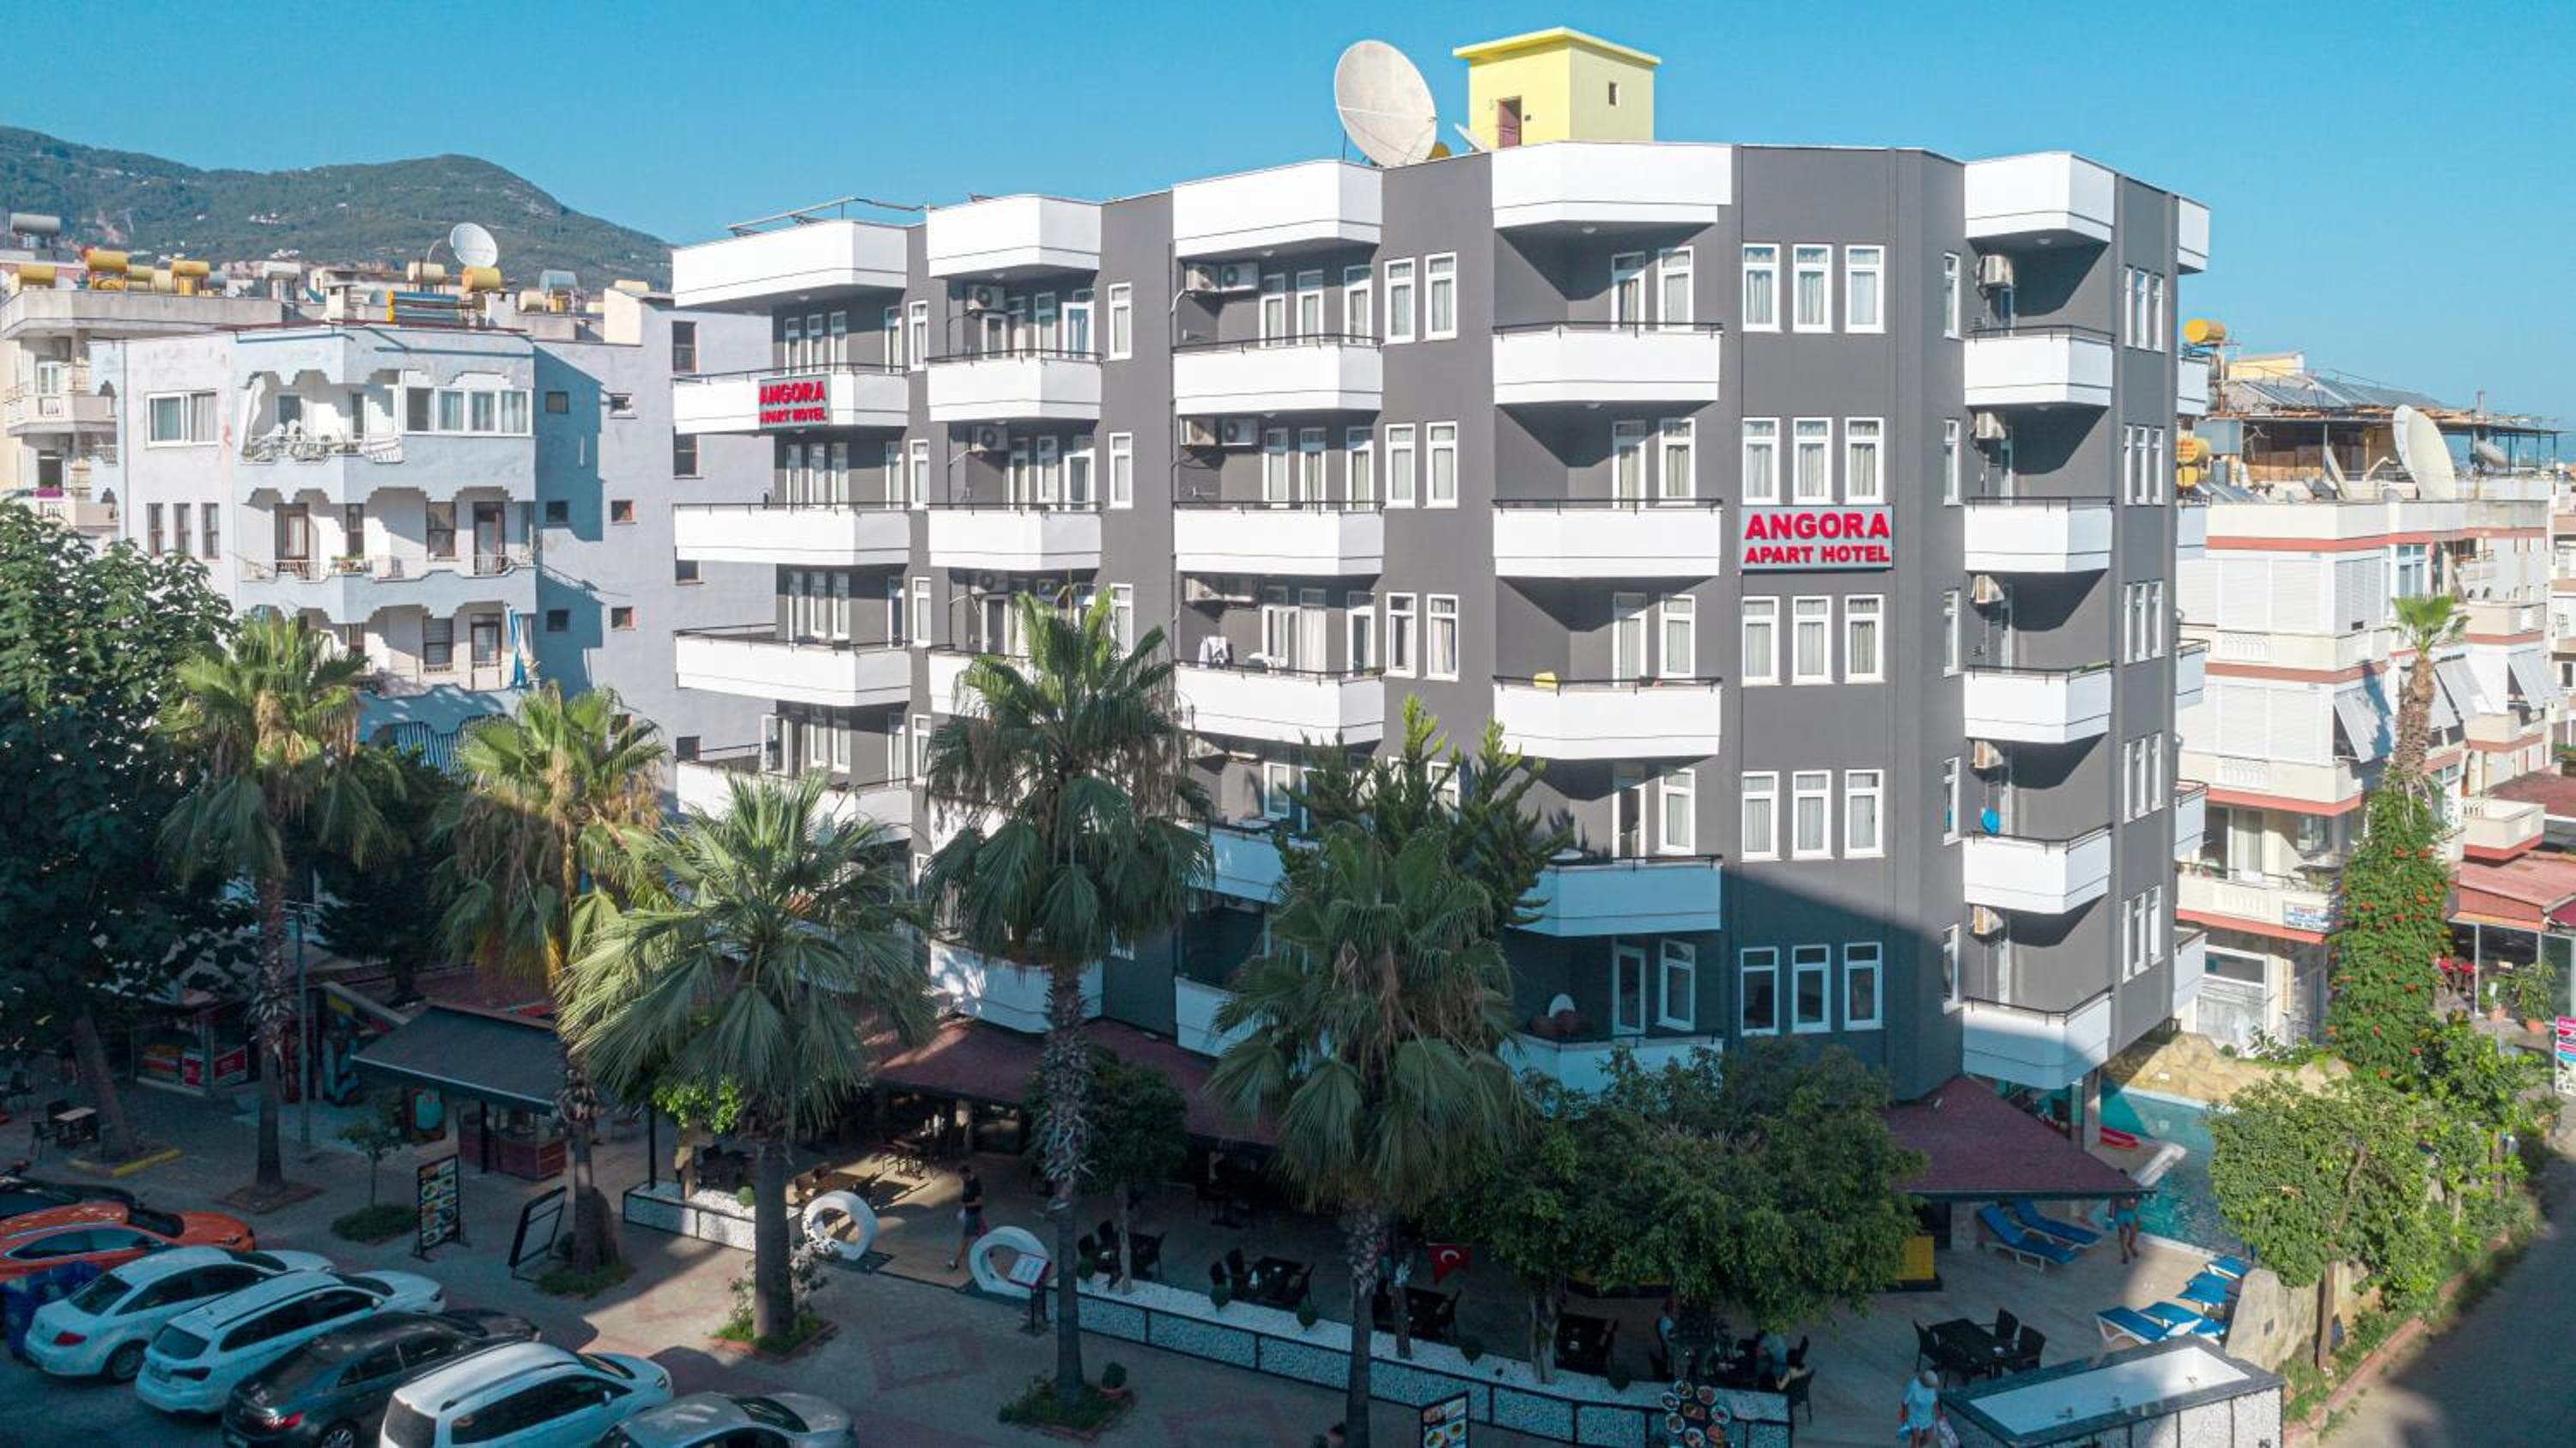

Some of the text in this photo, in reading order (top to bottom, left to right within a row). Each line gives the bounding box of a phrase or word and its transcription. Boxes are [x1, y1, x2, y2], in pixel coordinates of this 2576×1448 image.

[759, 380, 826, 405] ANGORA
[1744, 512, 1890, 540] ANGORA
[1744, 545, 1891, 564] APART HOTEL
